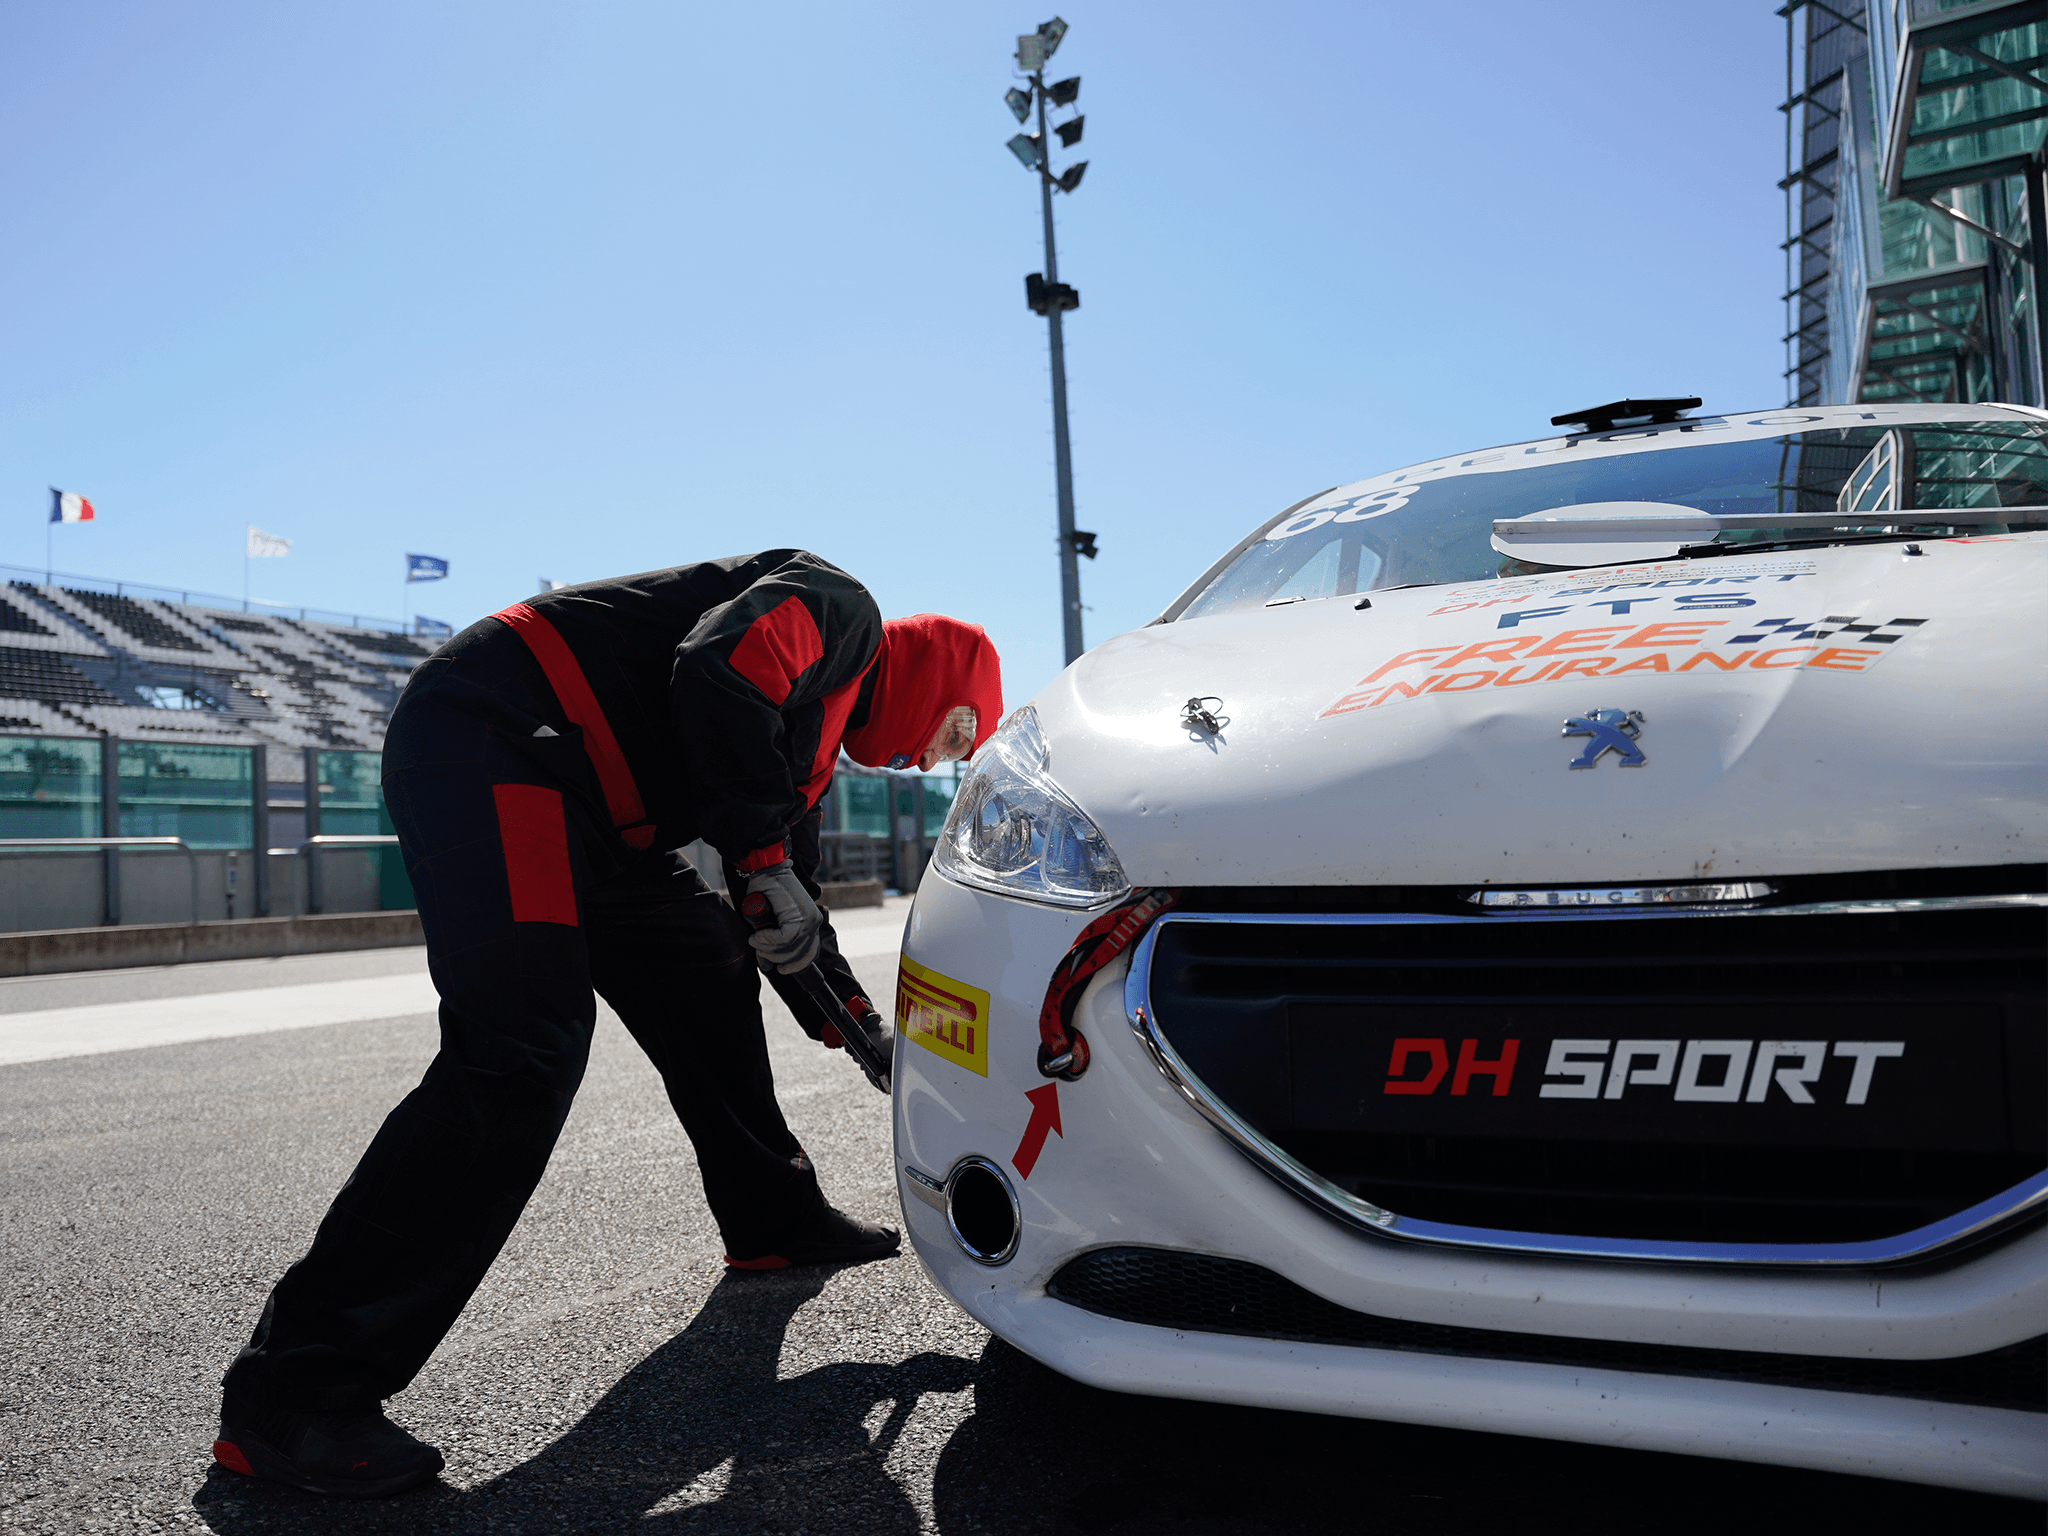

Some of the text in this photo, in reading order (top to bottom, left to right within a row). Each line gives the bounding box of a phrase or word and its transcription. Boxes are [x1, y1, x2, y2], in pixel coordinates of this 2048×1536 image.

[1393, 410, 1899, 484] PEUGEOT
[1265, 485, 1420, 541] 68
[1427, 594, 1534, 617] DH
[1548, 573, 1817, 599] SPORT
[1497, 592, 1757, 629] FTS
[1317, 646, 1883, 720] ENDURANCE
[1353, 620, 1731, 687] FREE
[1514, 886, 1724, 906] PEUGEOT
[1383, 1038, 1907, 1106] DH SPORT
